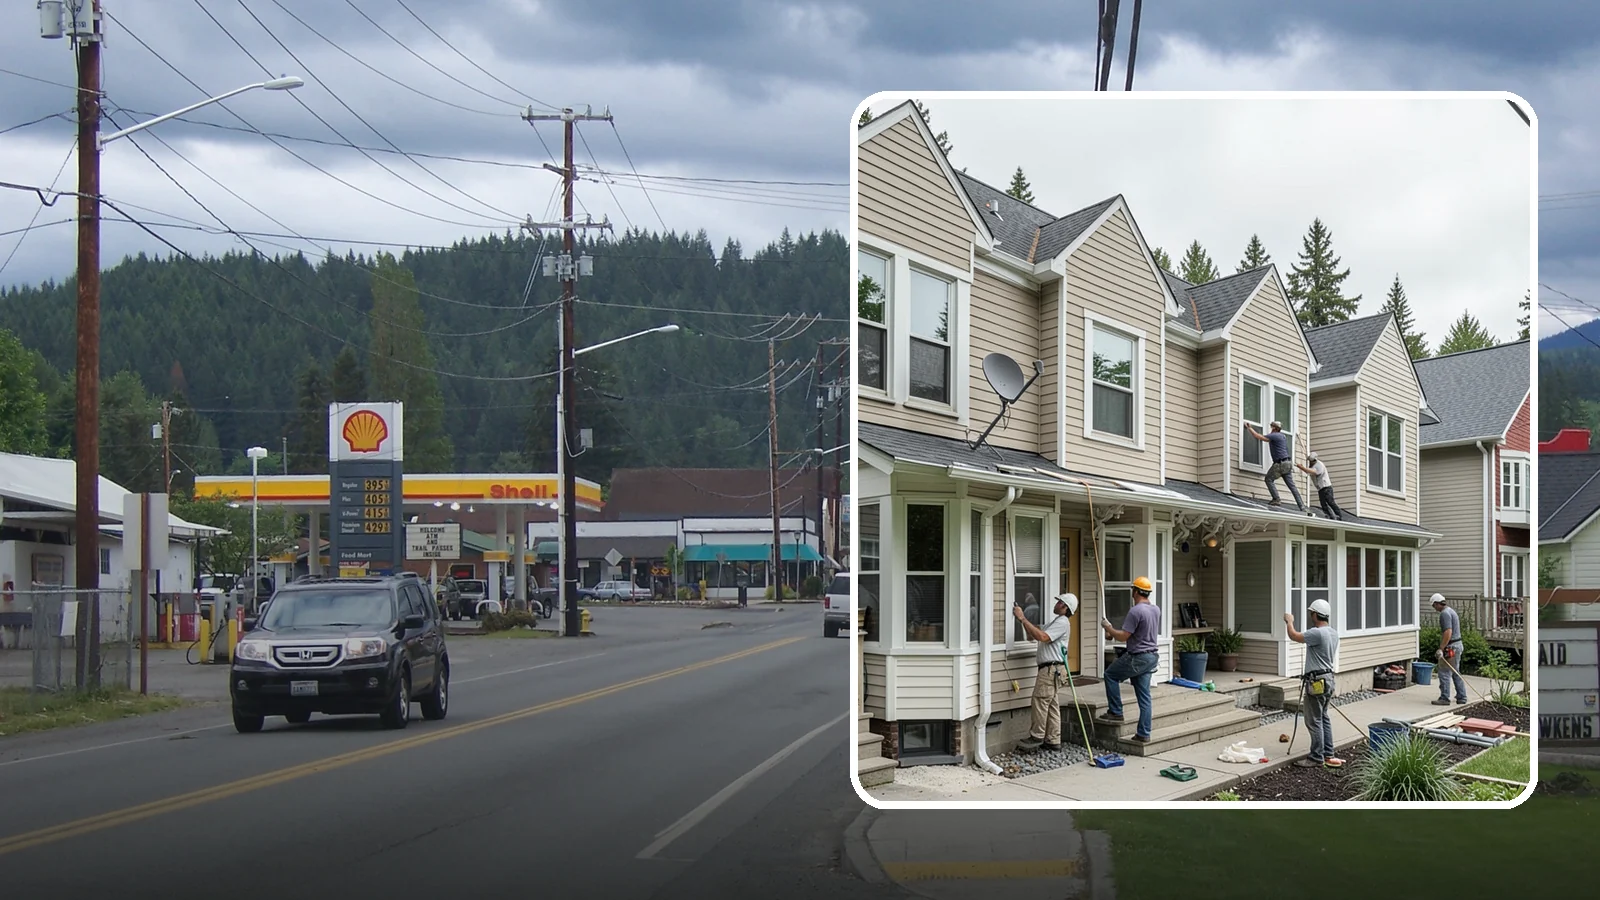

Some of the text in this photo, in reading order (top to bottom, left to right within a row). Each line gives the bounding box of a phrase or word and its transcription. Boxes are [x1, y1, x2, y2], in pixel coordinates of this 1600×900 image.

[366, 480, 383, 490] 395
[490, 484, 547, 499] Shell
[366, 494, 383, 504] 405
[366, 508, 383, 518] 415
[366, 522, 383, 532] 429
